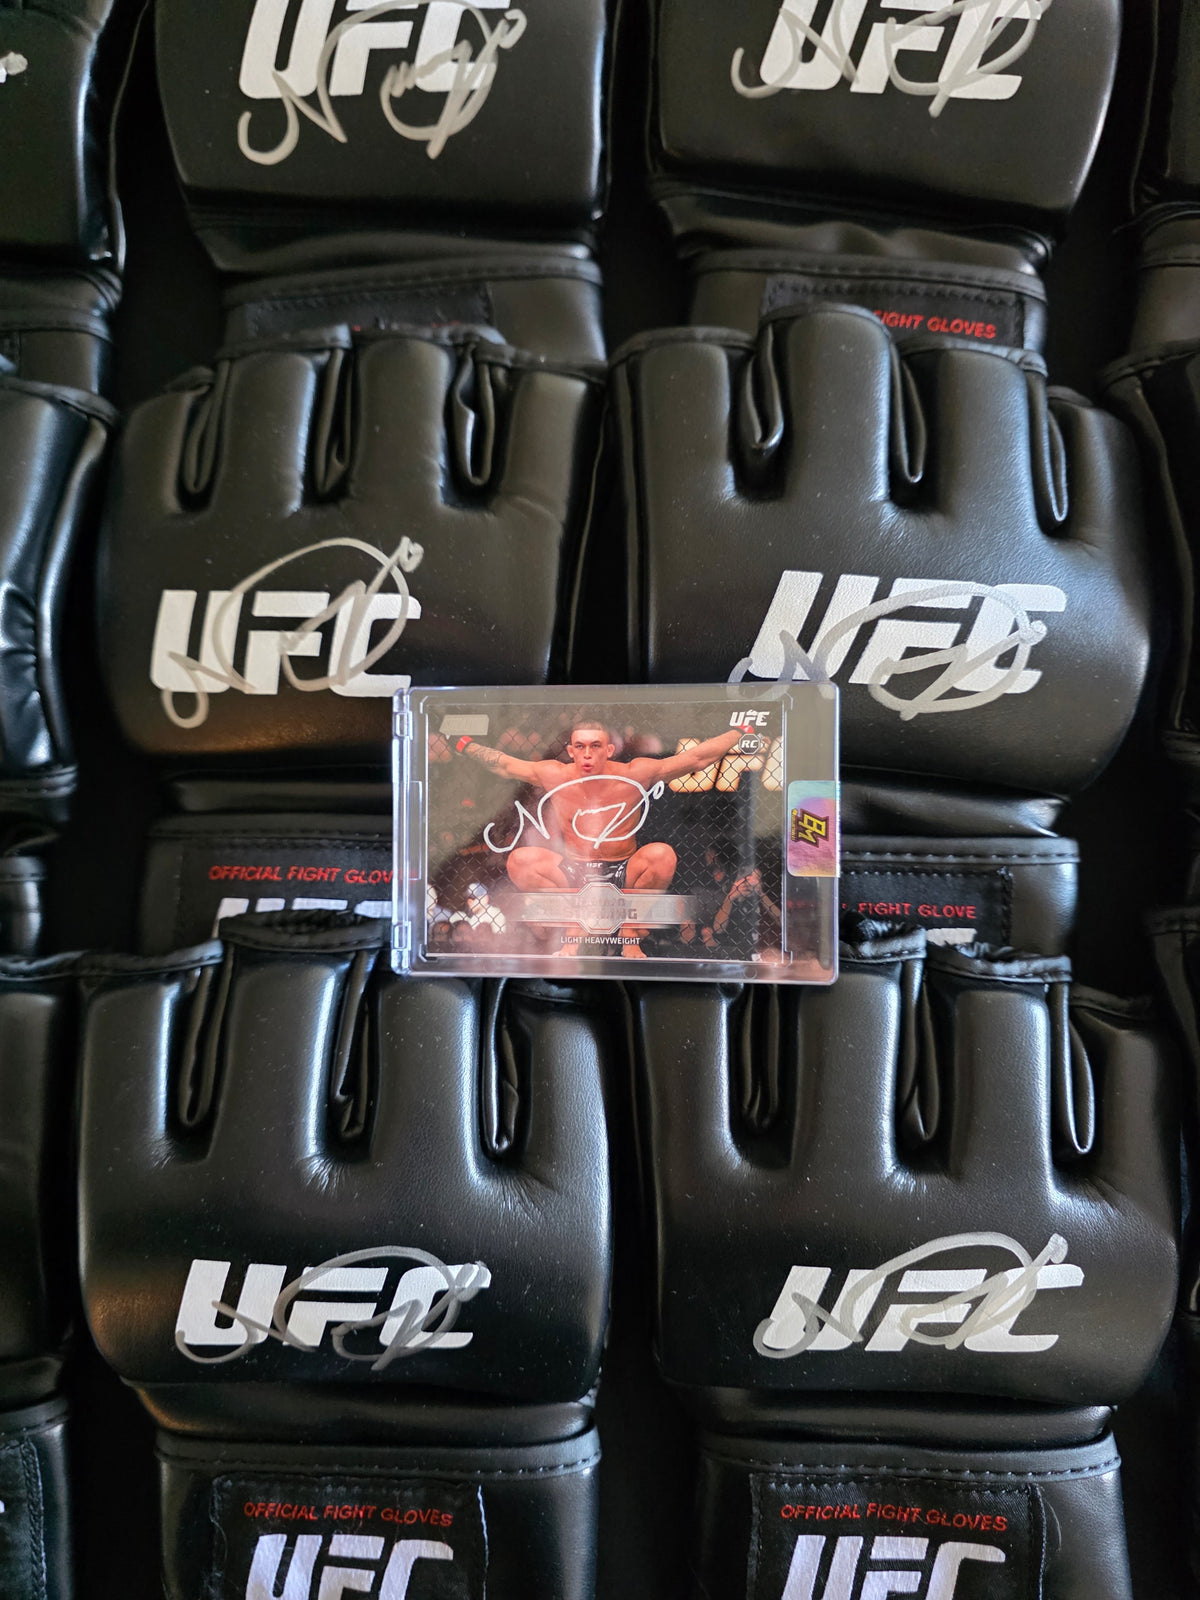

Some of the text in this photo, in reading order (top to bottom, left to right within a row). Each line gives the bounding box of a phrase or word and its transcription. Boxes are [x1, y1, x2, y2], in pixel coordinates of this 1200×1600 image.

[239, 0, 512, 98] UFC
[760, 0, 1043, 100] UFC
[926, 316, 997, 339] GLOVES
[150, 589, 421, 698] UFC
[745, 569, 1067, 694] UFC
[729, 709, 771, 727] UFC
[741, 740, 758, 749] RC
[208, 865, 406, 884] OFFICIAL FIGHT GLOV
[858, 902, 911, 916] FIGHT
[560, 936, 640, 945] LIGHT HEAVYWEIGHT
[175, 1259, 491, 1348] UFC
[761, 1265, 1084, 1352] UFC
[244, 1502, 454, 1527] OFFICIAL FIGHT GLOVES
[780, 1502, 1008, 1532] OFFICIAL FIGHT GLOVES
[245, 1533, 454, 1600] UFC
[781, 1534, 1006, 1600] UFC
